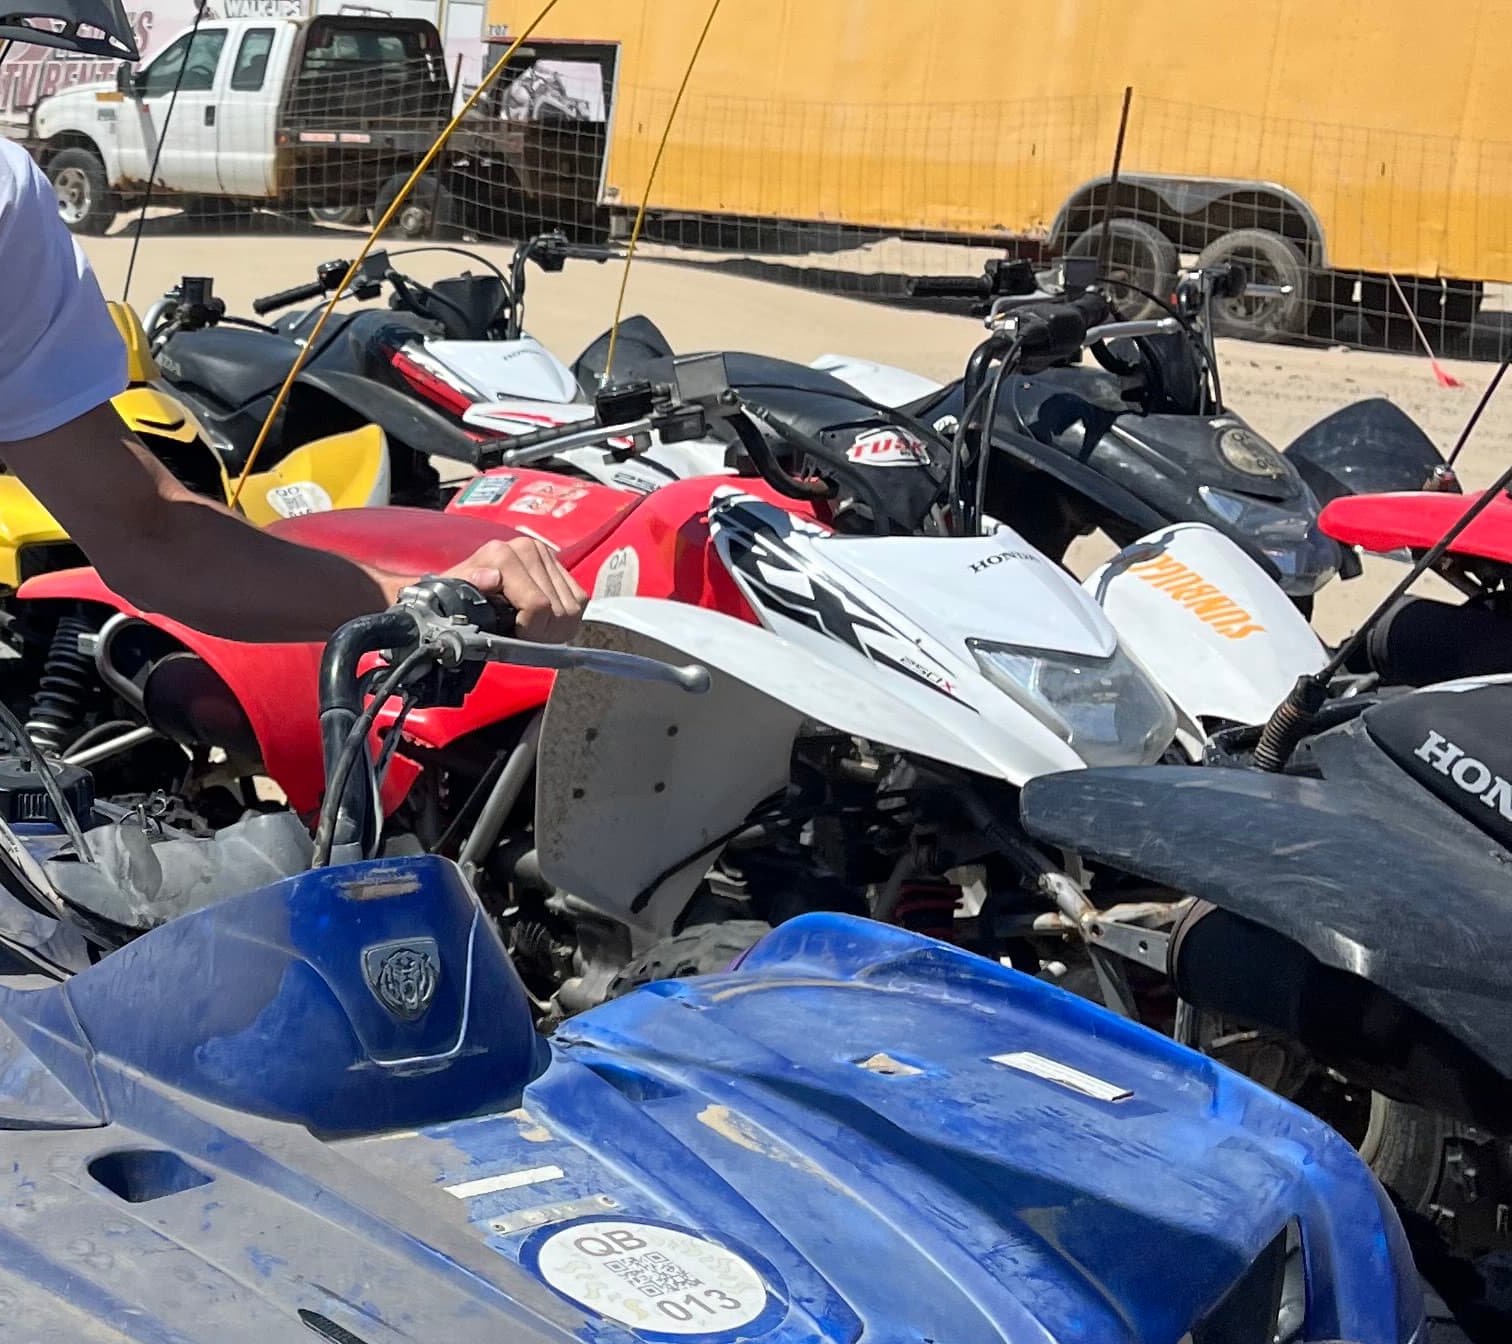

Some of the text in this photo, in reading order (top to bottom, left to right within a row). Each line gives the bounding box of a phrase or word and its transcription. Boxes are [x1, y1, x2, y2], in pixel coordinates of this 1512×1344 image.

[42, 60, 116, 98] RENT
[1413, 729, 1512, 823] HON
[573, 1229, 648, 1258] QB
[655, 1288, 742, 1322] 013
